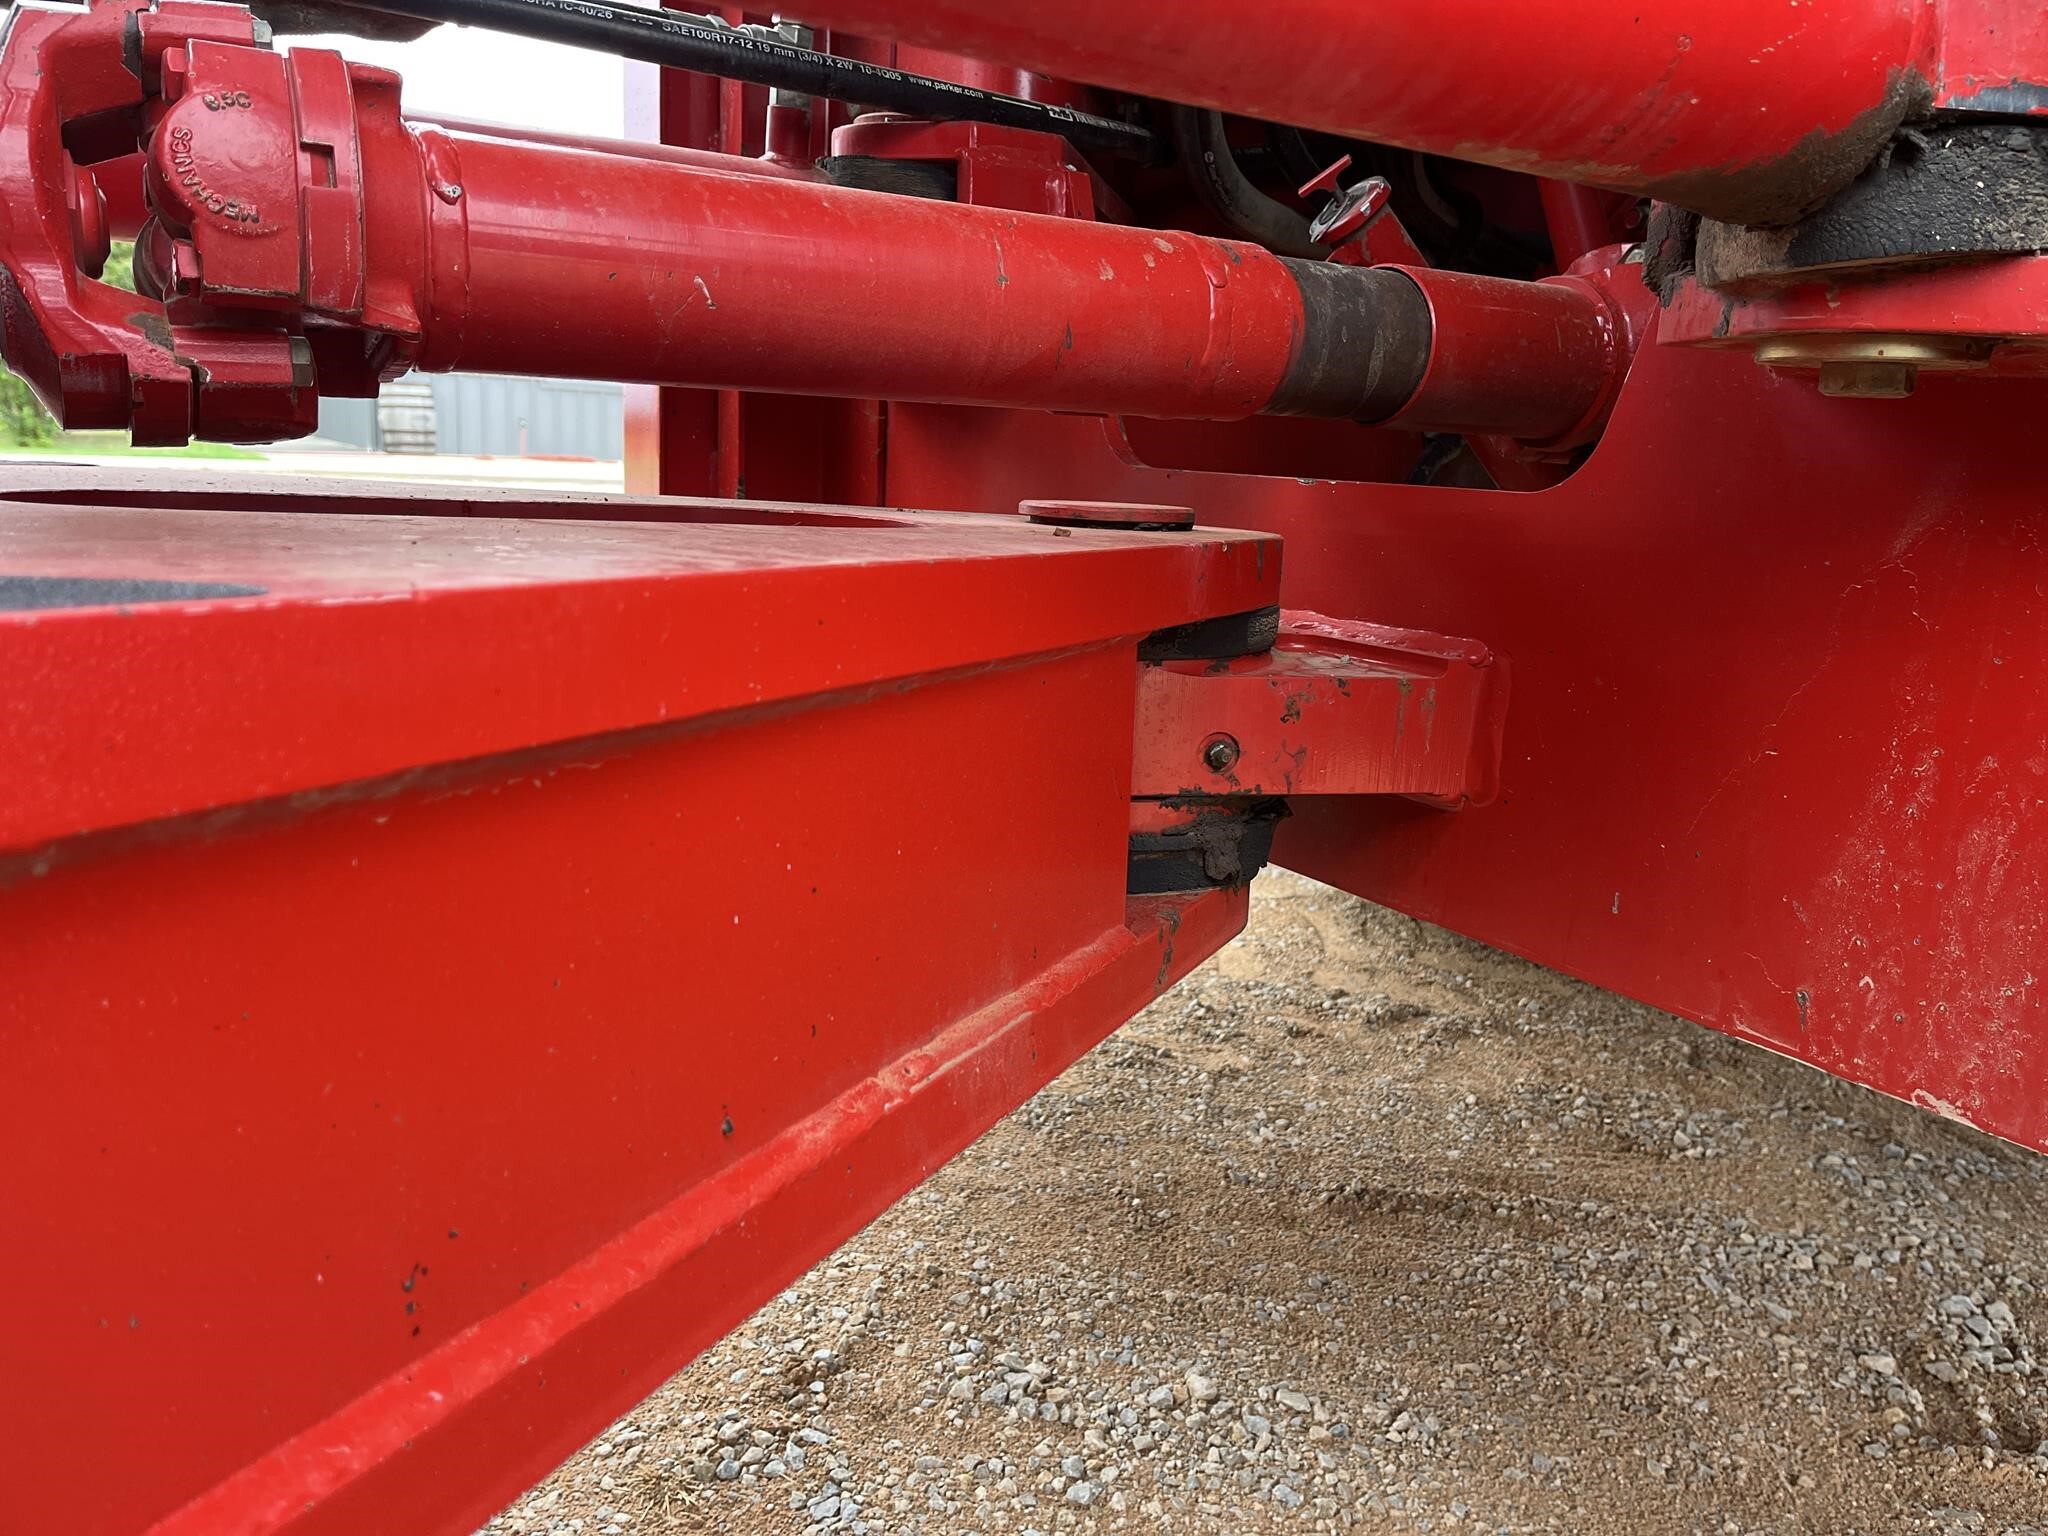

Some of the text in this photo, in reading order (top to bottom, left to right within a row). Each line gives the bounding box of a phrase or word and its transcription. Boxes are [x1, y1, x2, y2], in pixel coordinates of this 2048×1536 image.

[662, 23, 754, 49] SAE100R17-12
[757, 43, 771, 53] 19
[774, 48, 796, 58] mm
[798, 51, 823, 65] (3/4)
[826, 57, 834, 67] X
[837, 60, 853, 71] 2W
[908, 75, 984, 99] www.parker.com
[171, 127, 259, 223] MECHANICS
